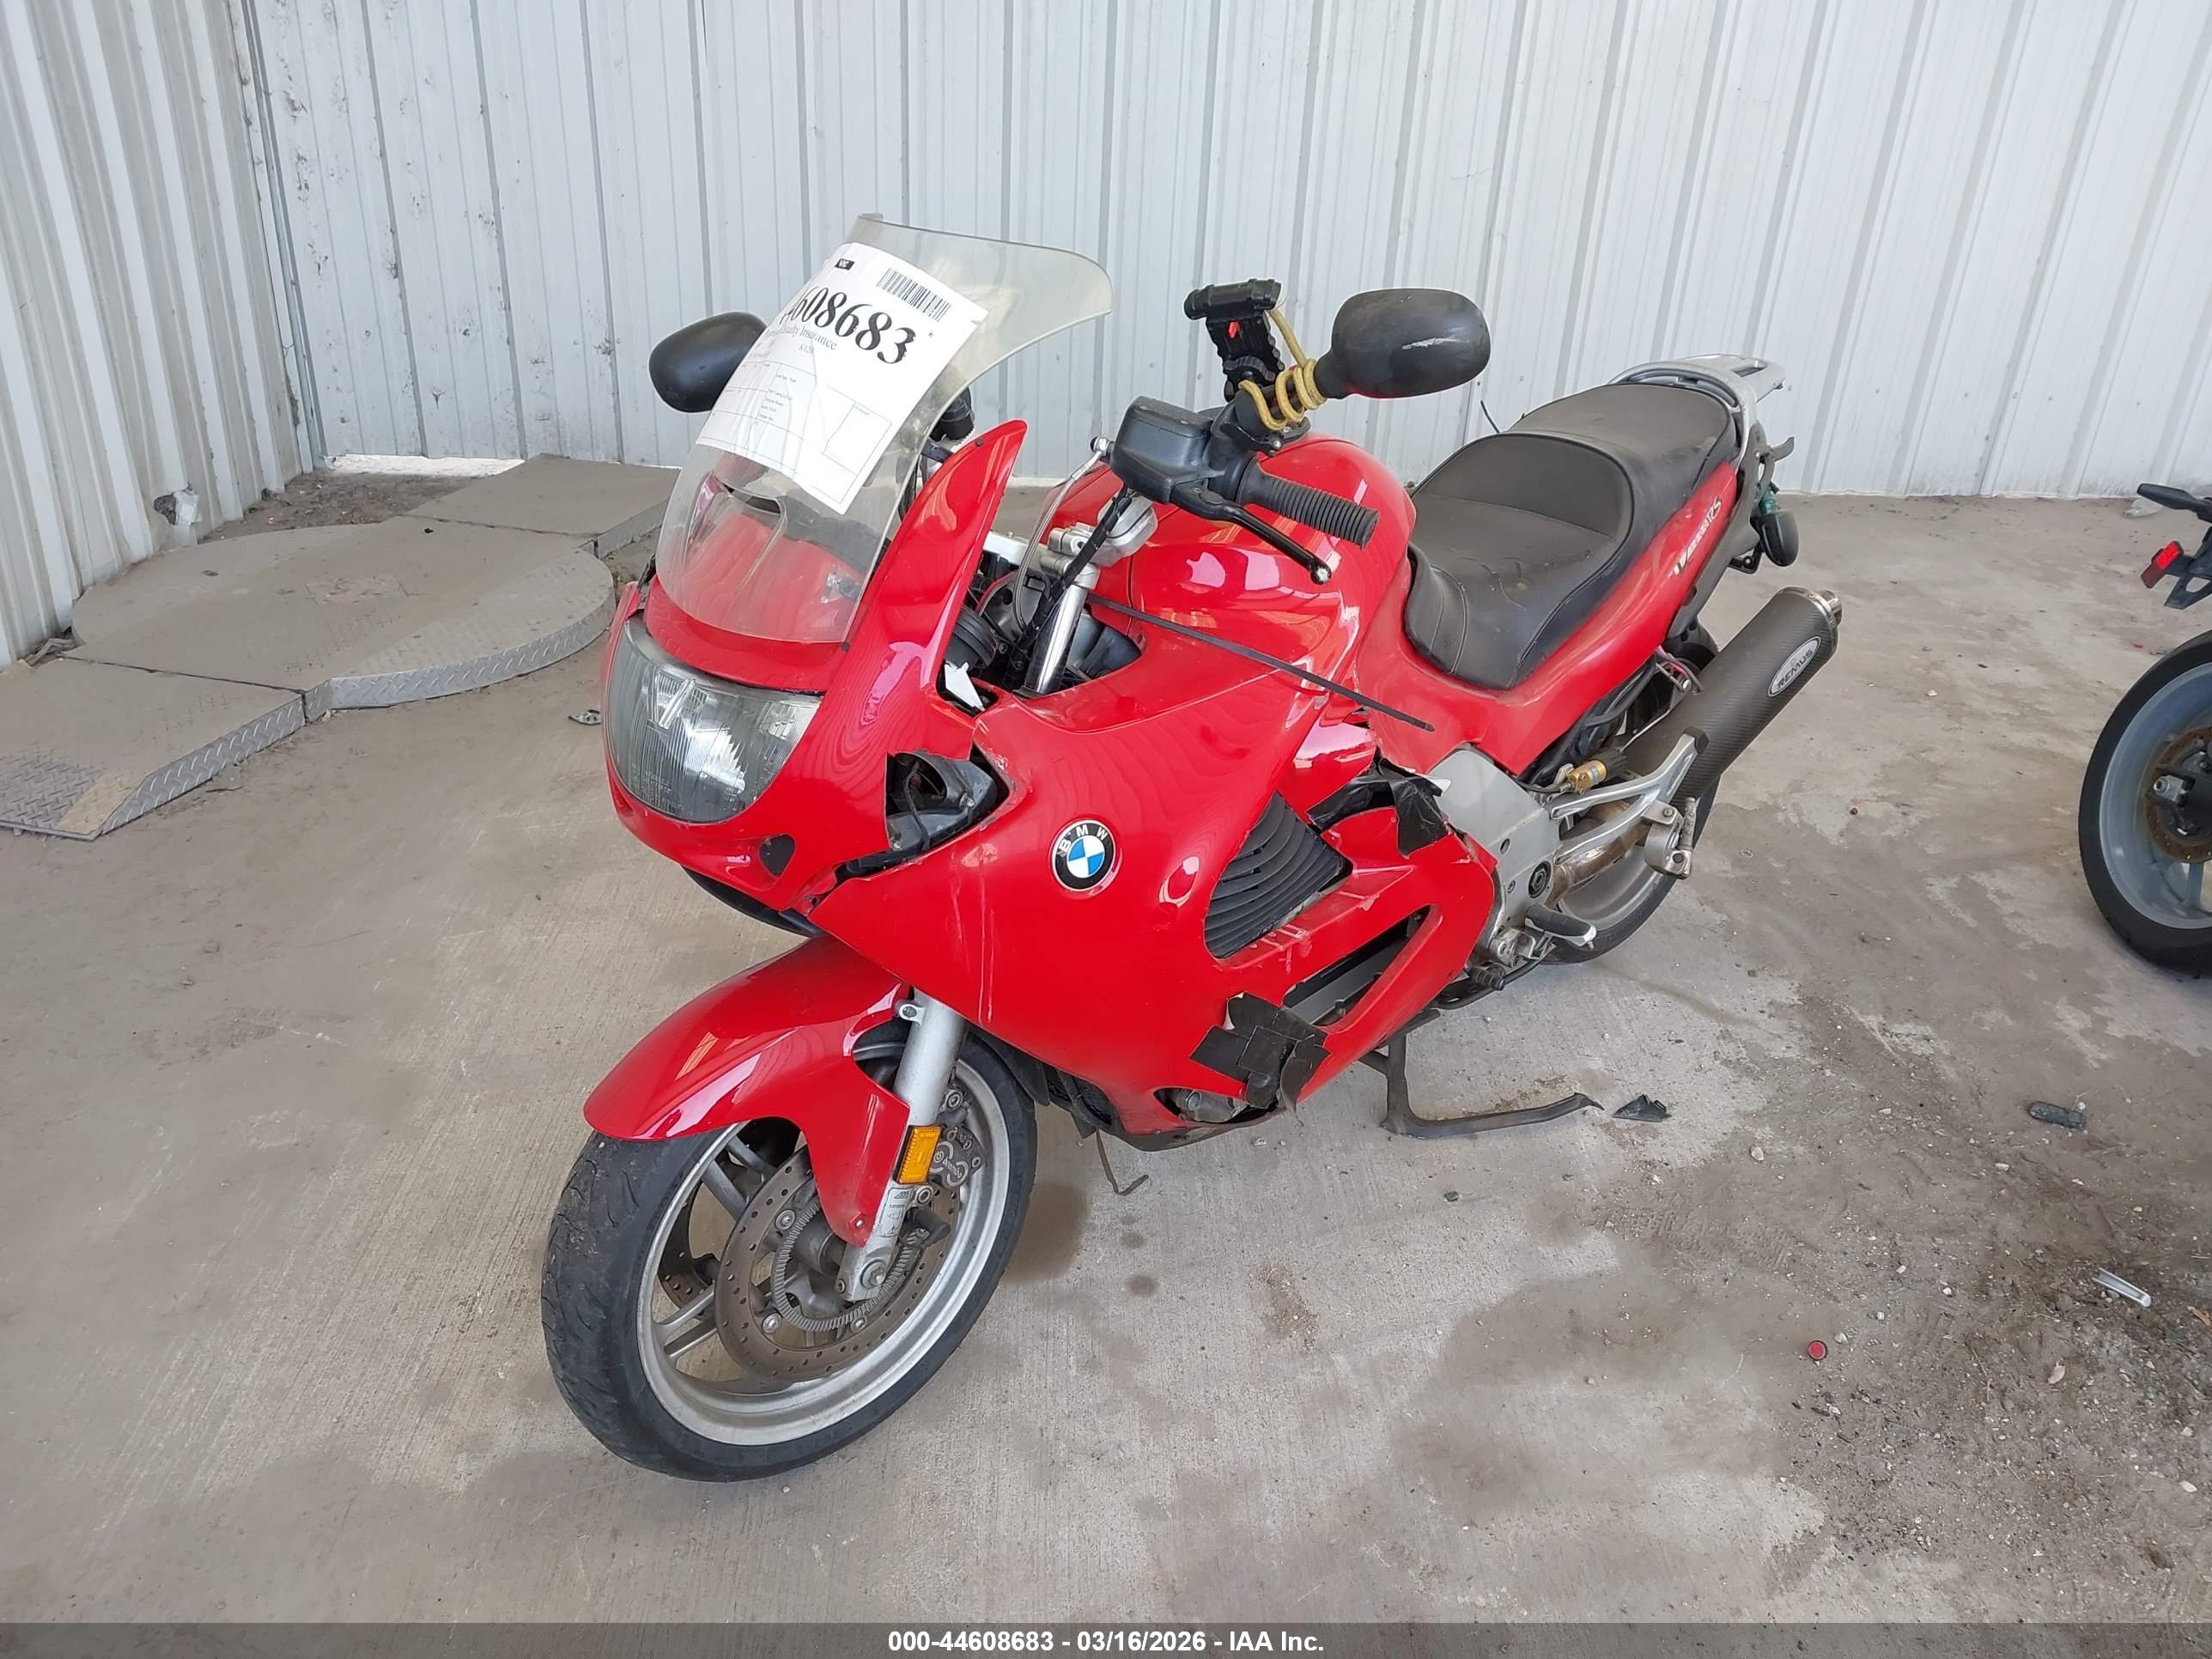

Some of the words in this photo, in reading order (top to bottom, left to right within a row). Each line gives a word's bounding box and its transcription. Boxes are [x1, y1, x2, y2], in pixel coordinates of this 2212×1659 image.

[799, 325, 838, 351] Insurance
[1778, 649, 1813, 689] REMUS
[1058, 823, 1108, 853] BMW
